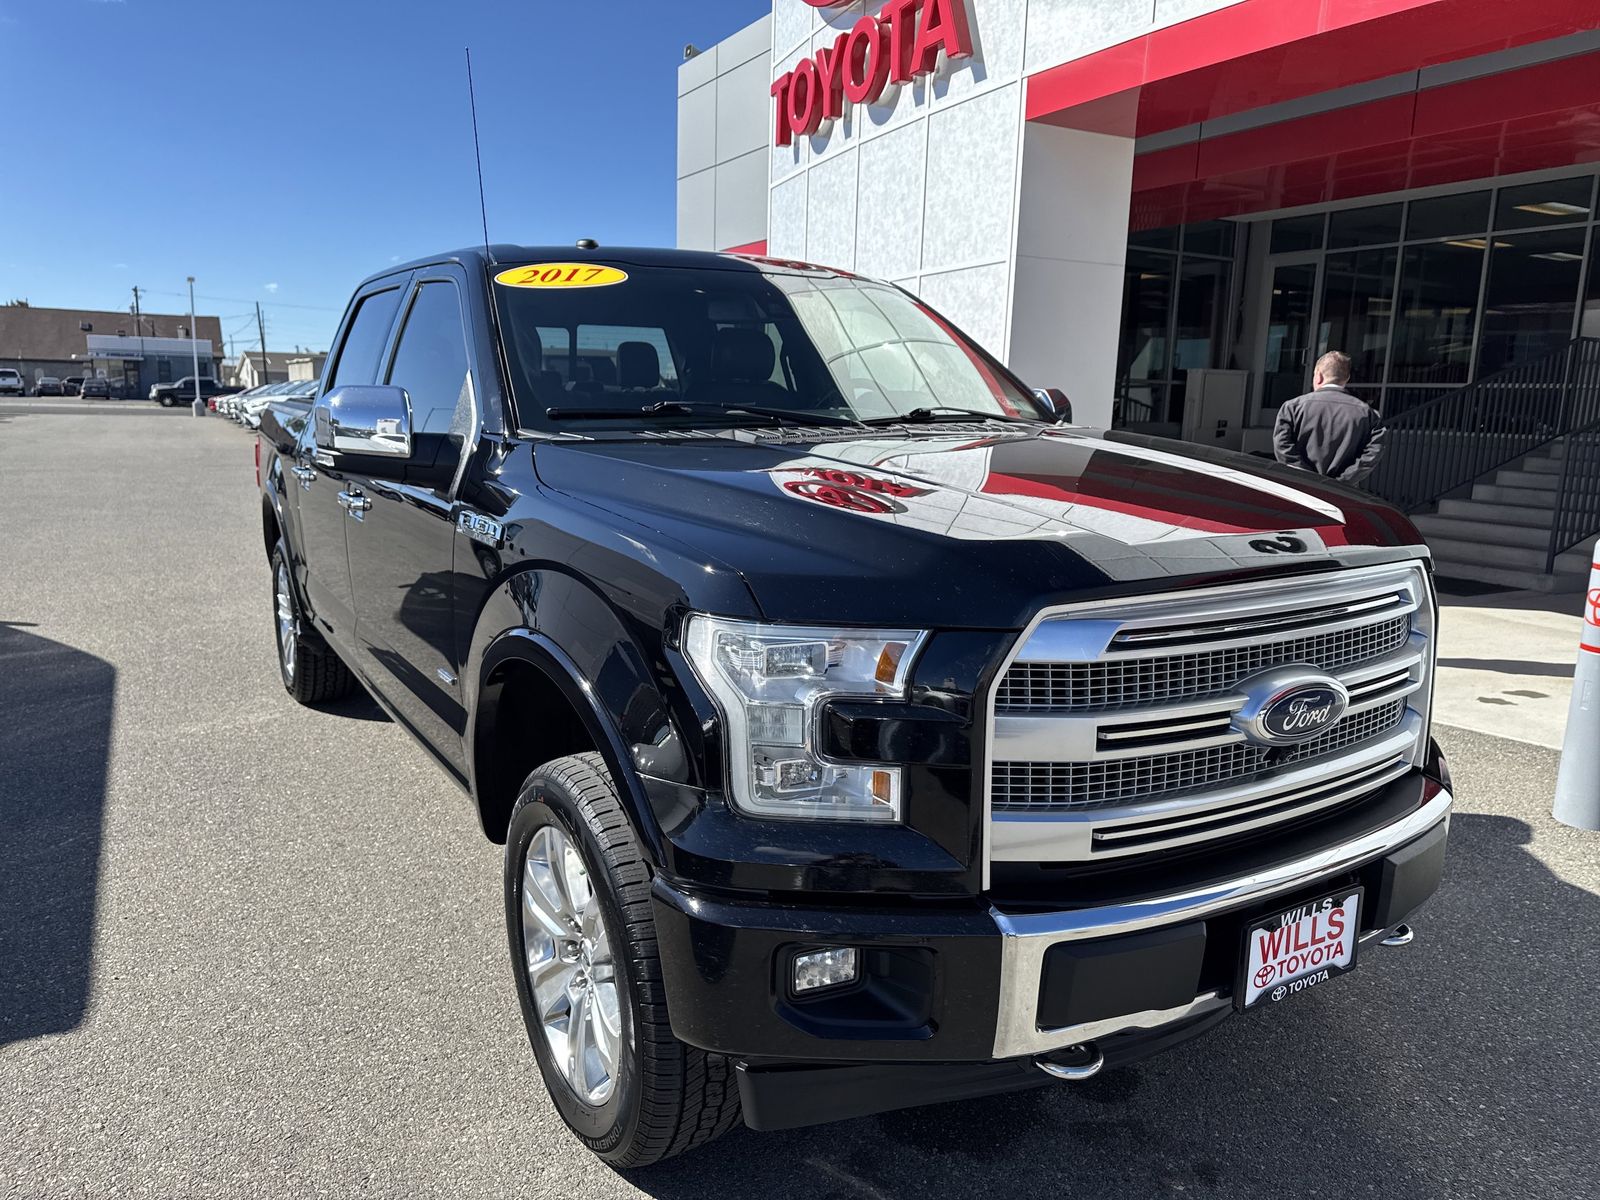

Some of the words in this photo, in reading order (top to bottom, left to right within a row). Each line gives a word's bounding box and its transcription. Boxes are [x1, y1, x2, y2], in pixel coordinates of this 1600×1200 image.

[771, 0, 973, 147] TOYOTA
[517, 267, 606, 284] 2017
[1282, 695, 1333, 731] Ford
[1280, 897, 1333, 927] WILLS
[1259, 907, 1345, 964] WILLS
[1277, 940, 1344, 978] TOYOTA
[1288, 969, 1329, 994] TOYOTA
